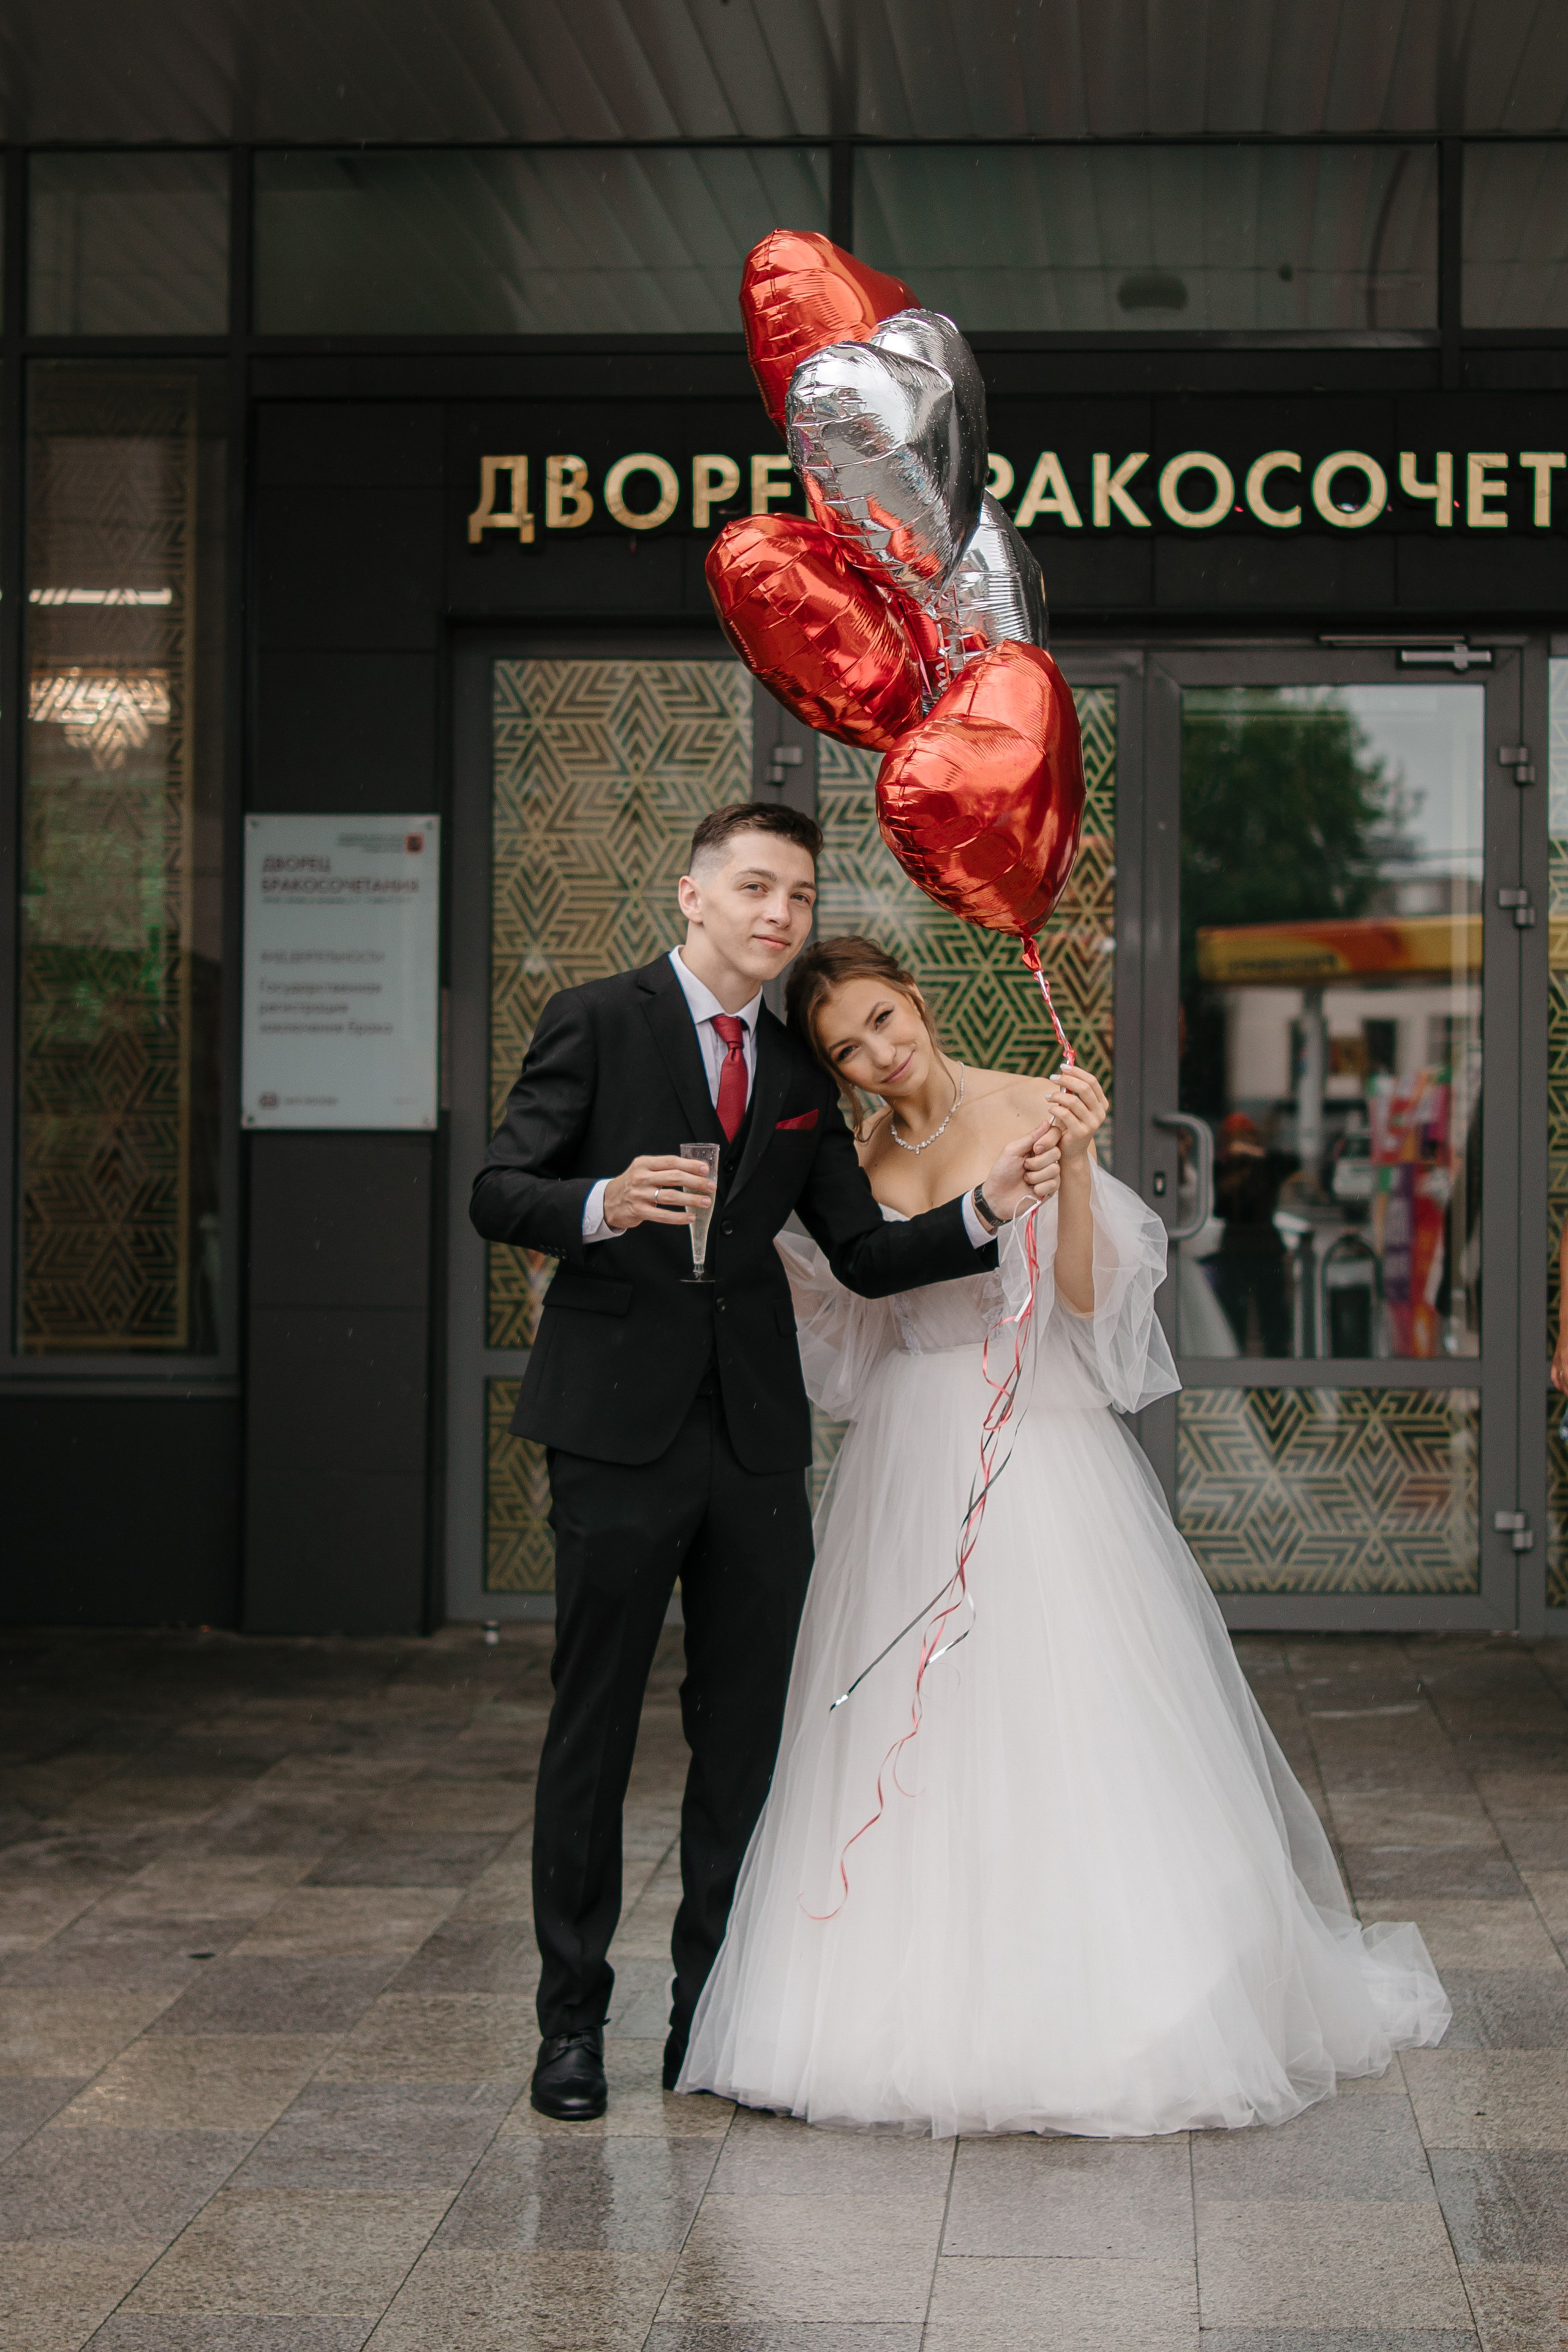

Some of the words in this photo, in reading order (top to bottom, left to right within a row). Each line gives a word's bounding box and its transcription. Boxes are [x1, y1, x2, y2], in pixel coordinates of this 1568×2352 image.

[468, 453, 818, 543] ДВОРЕ
[262, 855, 331, 873] ДВОРЕЦ
[262, 877, 420, 894] БРАКОСОЧЕТАНИЯ
